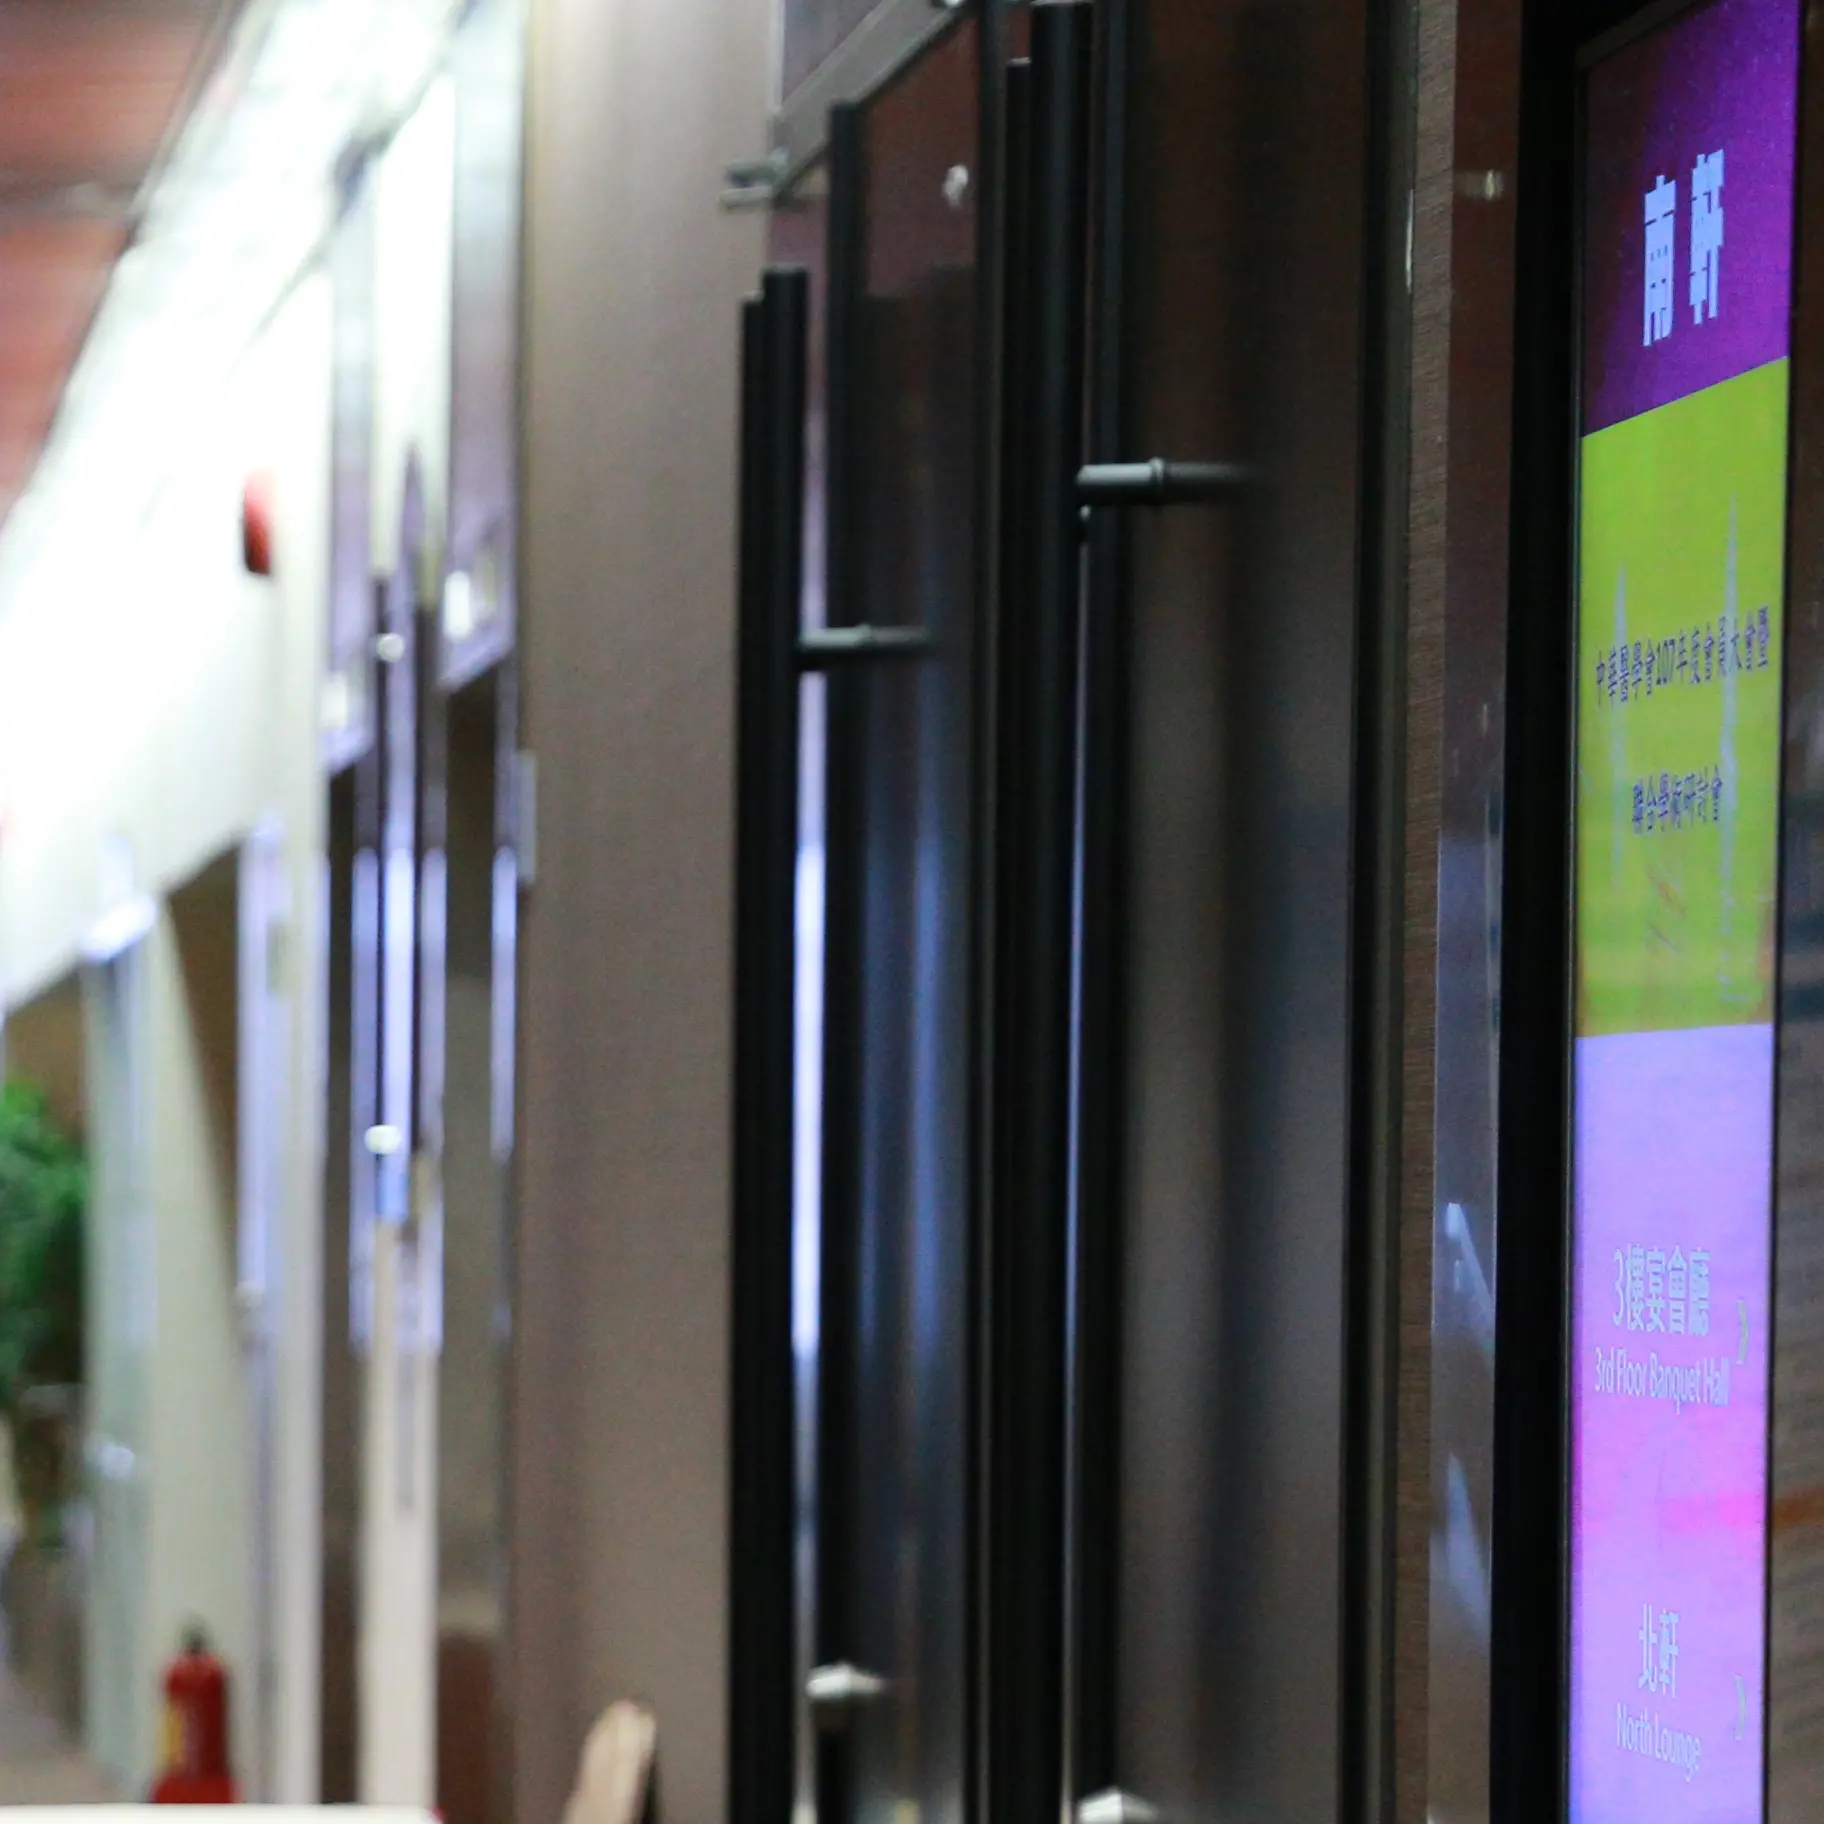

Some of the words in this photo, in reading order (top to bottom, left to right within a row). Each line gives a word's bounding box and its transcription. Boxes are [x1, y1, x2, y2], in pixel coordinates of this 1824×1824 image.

[1642, 149, 1725, 348] 南軒
[1613, 1243, 1711, 1338] 3樓宴會廳
[1594, 1347, 1614, 1396] 3rd
[1617, 1349, 1649, 1399] Floor
[1650, 1353, 1701, 1415] Banquet
[1703, 1357, 1730, 1407] Hall
[1638, 1604, 1680, 1698] 北軒
[1616, 1702, 1651, 1757] North
[1653, 1713, 1702, 1784] Lounge
